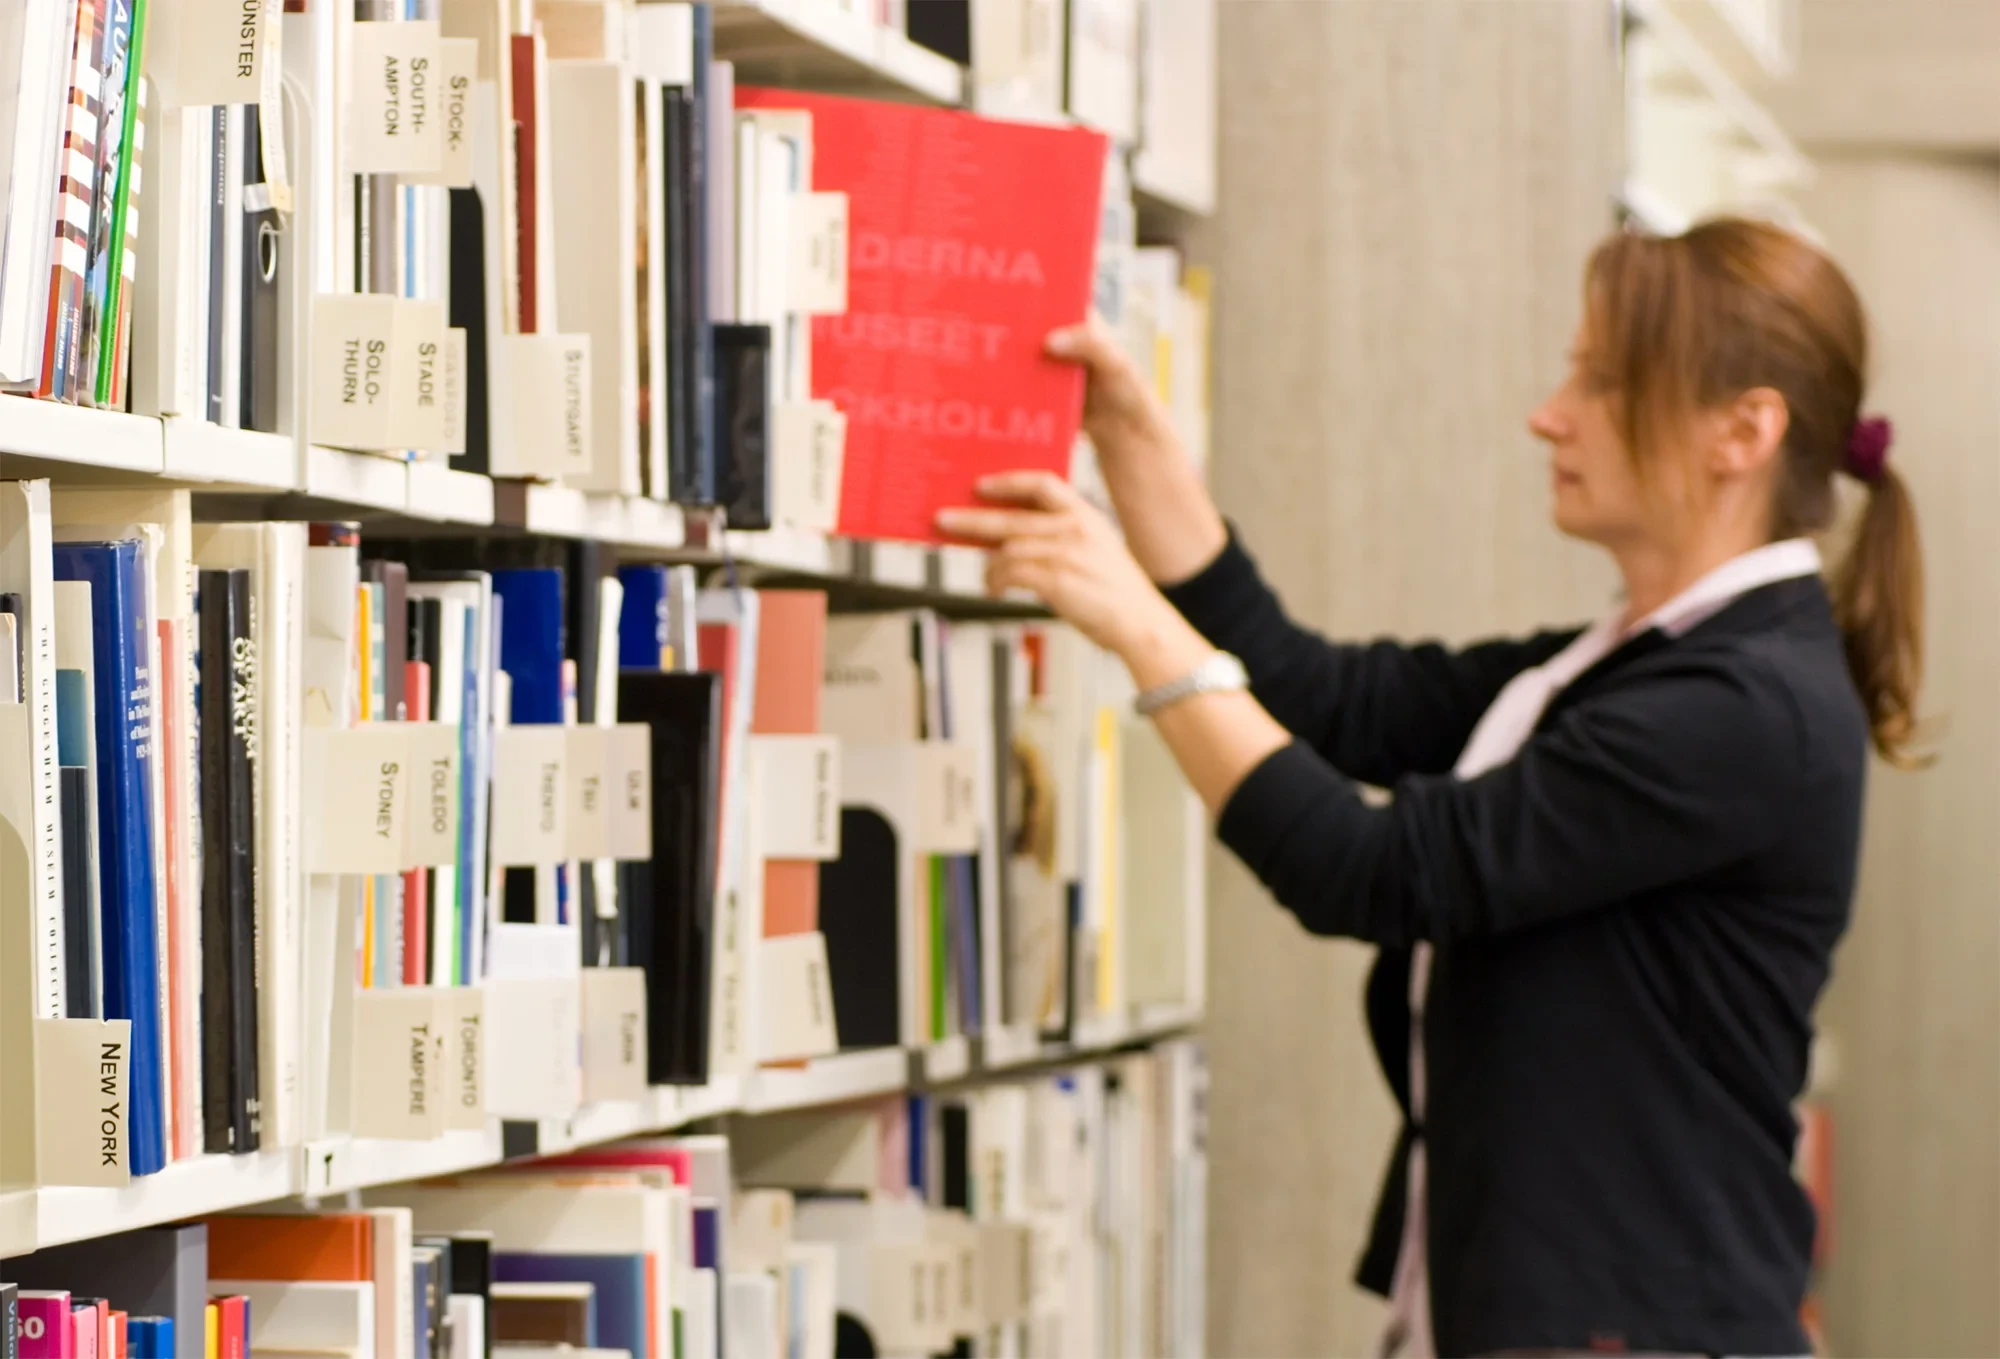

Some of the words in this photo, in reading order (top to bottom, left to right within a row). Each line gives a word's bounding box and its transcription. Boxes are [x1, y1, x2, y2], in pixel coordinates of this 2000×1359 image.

[237, 0, 261, 77] ÜNSTER
[385, 55, 399, 136] AMPTON
[410, 57, 428, 134] SOUTH-
[448, 75, 469, 152] STOCK-
[852, 231, 1046, 290] DERNA
[343, 338, 359, 404] THURN
[365, 339, 385, 404] SOLO-
[418, 342, 437, 408] STADE
[811, 312, 1010, 364] USEET
[376, 761, 399, 838] SYDNEY
[431, 756, 450, 835] TOLEDO
[49, 915, 60, 1019] COLLECTIO
[101, 1043, 122, 1096] NEW
[409, 1022, 428, 1115] TAMPERE
[460, 1013, 478, 1107] TORONTO
[101, 1102, 120, 1167] YORK
